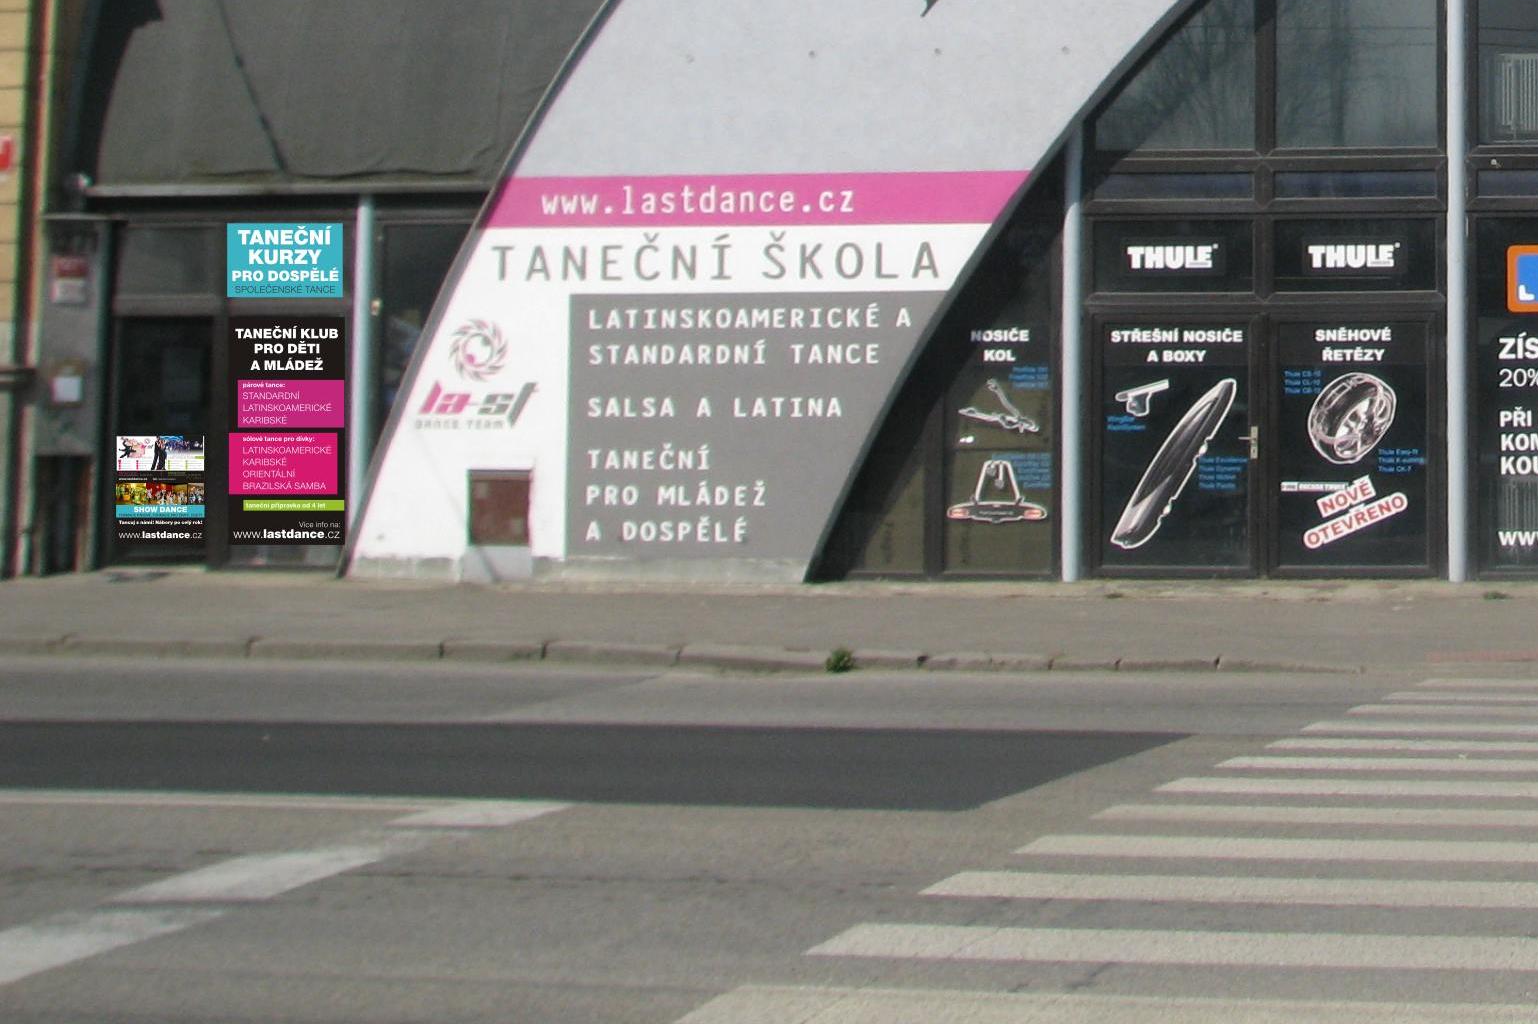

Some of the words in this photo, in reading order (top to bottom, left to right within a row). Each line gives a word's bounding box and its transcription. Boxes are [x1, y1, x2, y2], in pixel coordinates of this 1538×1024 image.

[541, 184, 855, 216] www.lastdance.cz
[237, 226, 332, 245] TANEČNÍ
[248, 249, 322, 265] KURZY
[491, 232, 732, 283] TANEČNÍ
[760, 230, 941, 280] ŠKOLA
[1127, 244, 1214, 270] THULE
[1307, 243, 1395, 268] THULE
[231, 270, 264, 282] PRO
[268, 267, 339, 282] DOSPĚLÉ
[234, 284, 302, 294] SPOLEČENSKÉ
[306, 285, 336, 294] TANCE
[588, 302, 881, 331] LATINSKOAMERICKÉ
[895, 308, 912, 328] A
[235, 326, 297, 339] TANEČNÍ
[301, 328, 339, 339] KLUB
[971, 328, 1030, 343] NOSIČE
[1111, 327, 1179, 343] STŘEŠNÍ
[1183, 328, 1243, 343] NOSIČE
[1314, 326, 1392, 343] SNĚHOVÉ
[254, 343, 284, 354] PRO
[288, 341, 320, 354] DĚTI
[588, 339, 766, 365] STANDARDNÍ
[790, 344, 881, 364] TANCE
[1322, 345, 1385, 362] ŘETĚZY
[983, 349, 1016, 362] KOL
[1147, 350, 1158, 362] A
[1163, 350, 1207, 362] BOXY
[250, 360, 260, 371] A
[264, 357, 323, 371] MLÁDEŽ
[243, 391, 300, 400] STANDARDNÍ
[243, 402, 332, 412] LATINSKOAMERICKÉ
[587, 397, 675, 418] SALSA
[697, 397, 712, 417] A
[734, 397, 842, 418] LATINA
[243, 415, 288, 425] KARIBSKÉ
[1499, 406, 1532, 427] PŘI
[243, 445, 332, 455] LATINSKOAMERICKÉ
[587, 442, 711, 471] TANEČNÍ
[243, 456, 287, 466] KARIBSKÉ
[243, 469, 296, 479] ORIENTÁLNÍ
[243, 481, 292, 490] BRAZILSKÁ
[294, 482, 326, 490] SAMBA
[586, 486, 639, 507] PRO
[657, 478, 766, 507] MLÁDEŽ
[119, 530, 203, 539] www.lastdance.cz
[233, 529, 340, 539] www.lastdance.cz
[585, 521, 600, 542] A
[622, 514, 749, 543] DOSPĚLÉ
